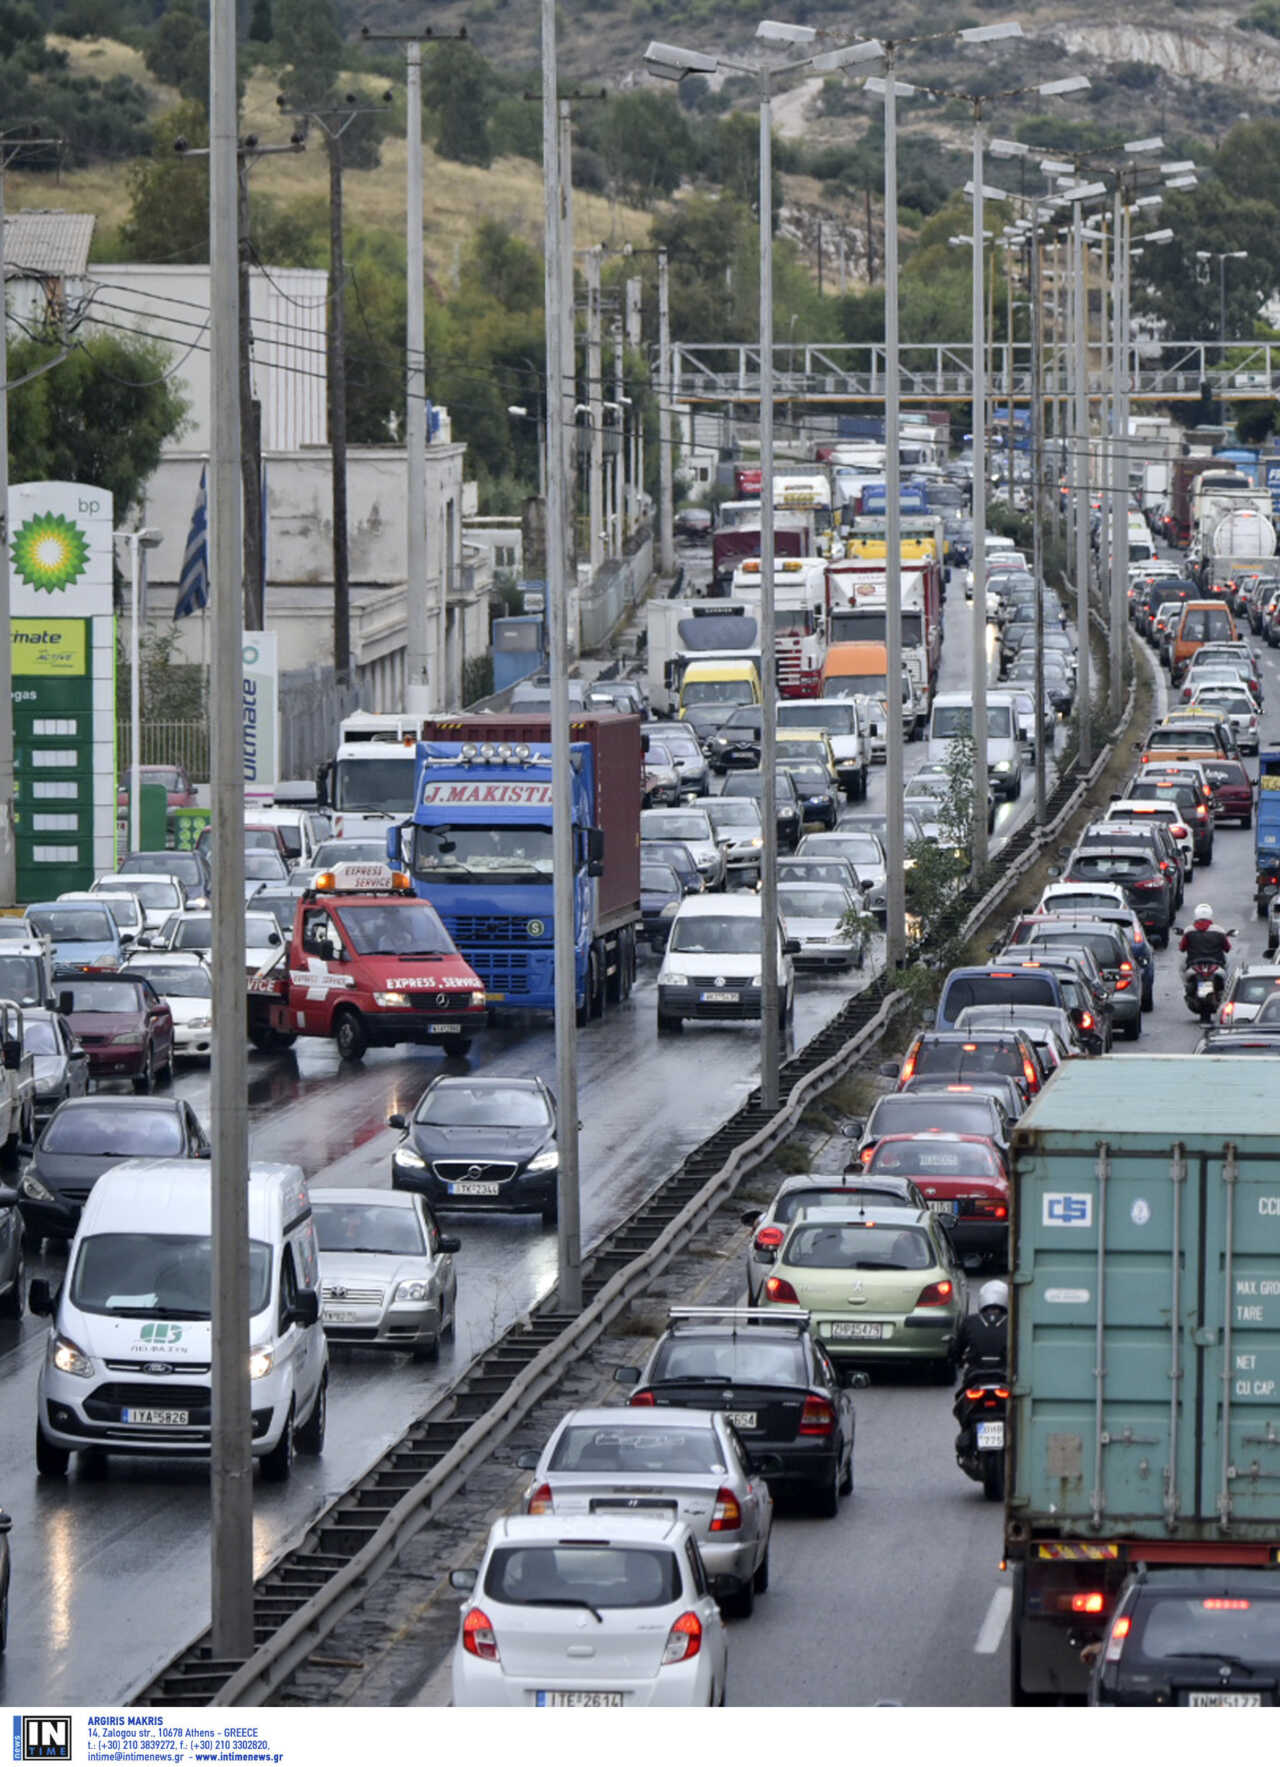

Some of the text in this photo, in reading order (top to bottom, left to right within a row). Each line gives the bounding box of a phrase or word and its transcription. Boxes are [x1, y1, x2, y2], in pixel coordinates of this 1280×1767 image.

[78, 498, 100, 515] bp
[425, 785, 552, 803] J.MAKISTI
[386, 977, 437, 989] EXPRESS
[1236, 1305, 1264, 1320] TARE
[1236, 1355, 1256, 1369] NET
